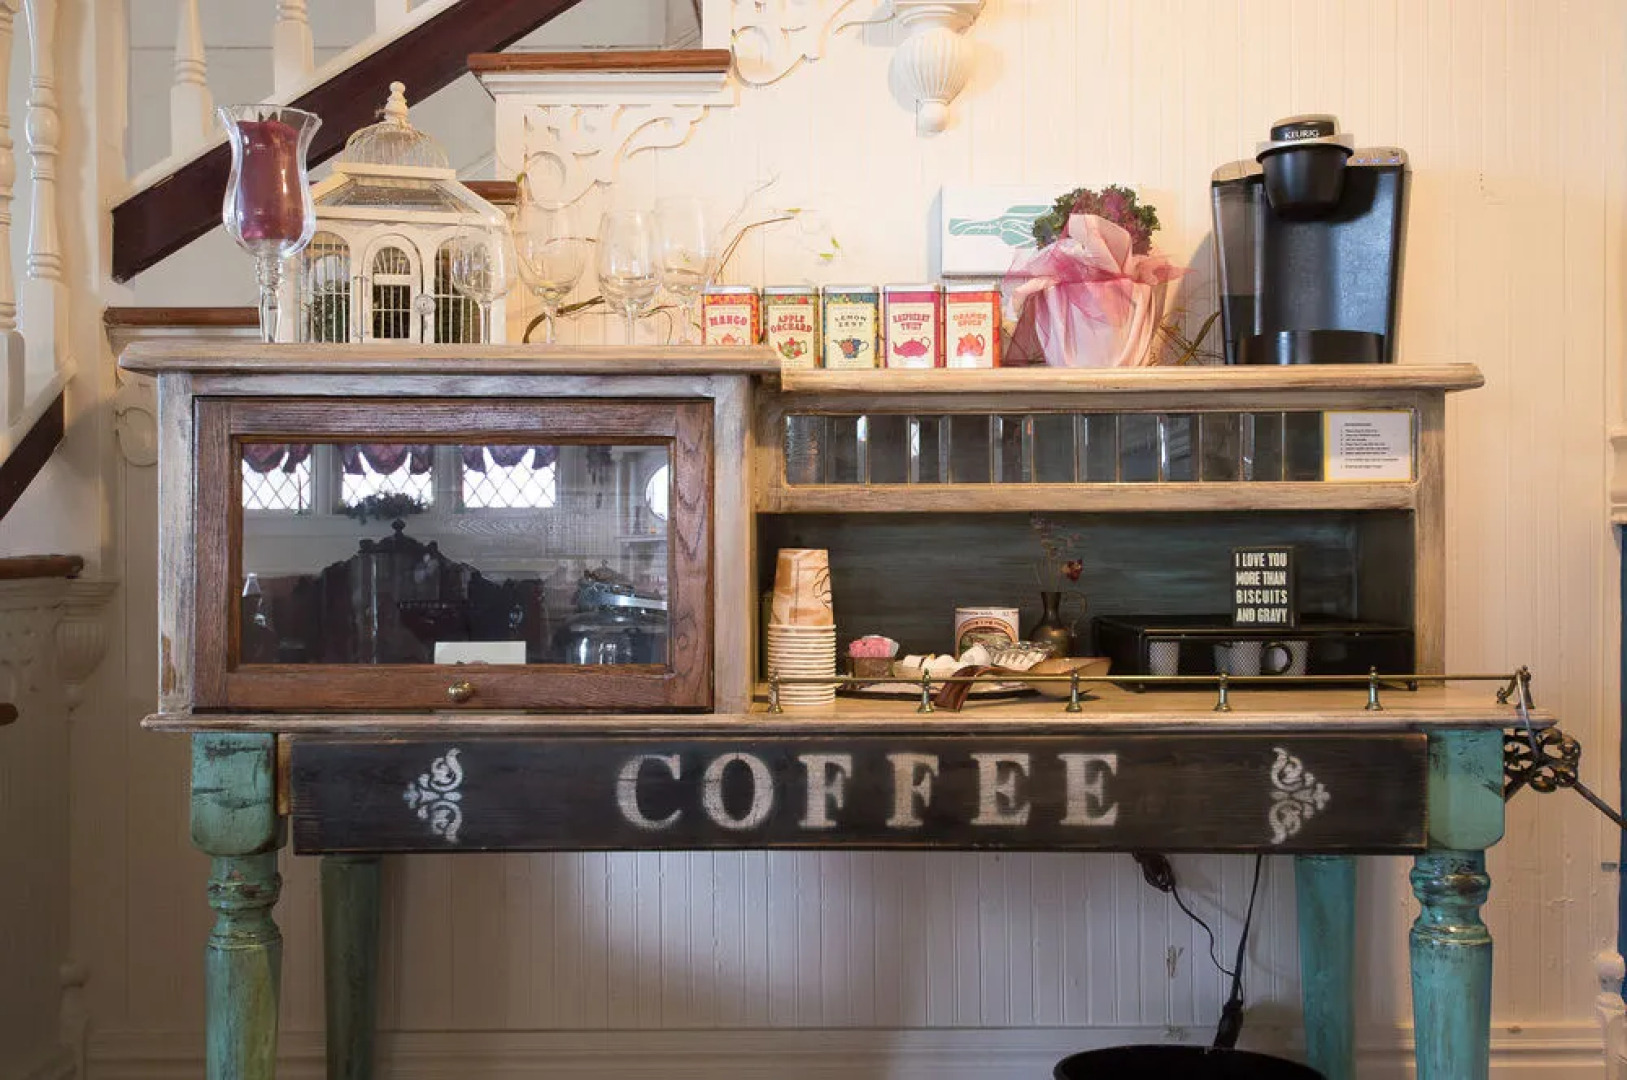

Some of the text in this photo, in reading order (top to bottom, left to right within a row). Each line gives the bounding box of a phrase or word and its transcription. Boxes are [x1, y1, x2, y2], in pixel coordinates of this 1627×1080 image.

[1285, 130, 1319, 139] KEURIG
[709, 314, 747, 326] MANGO
[779, 314, 805, 323] APPLE
[835, 314, 866, 322] LEMON
[770, 323, 812, 333] ORCHARD
[1235, 553, 1288, 567] I LOVE YOU
[1236, 571, 1287, 585] MORE THAN
[1236, 589, 1288, 604] BISCUITS
[1236, 608, 1288, 623] AND GRAVY
[616, 753, 1119, 829] COFFEE
